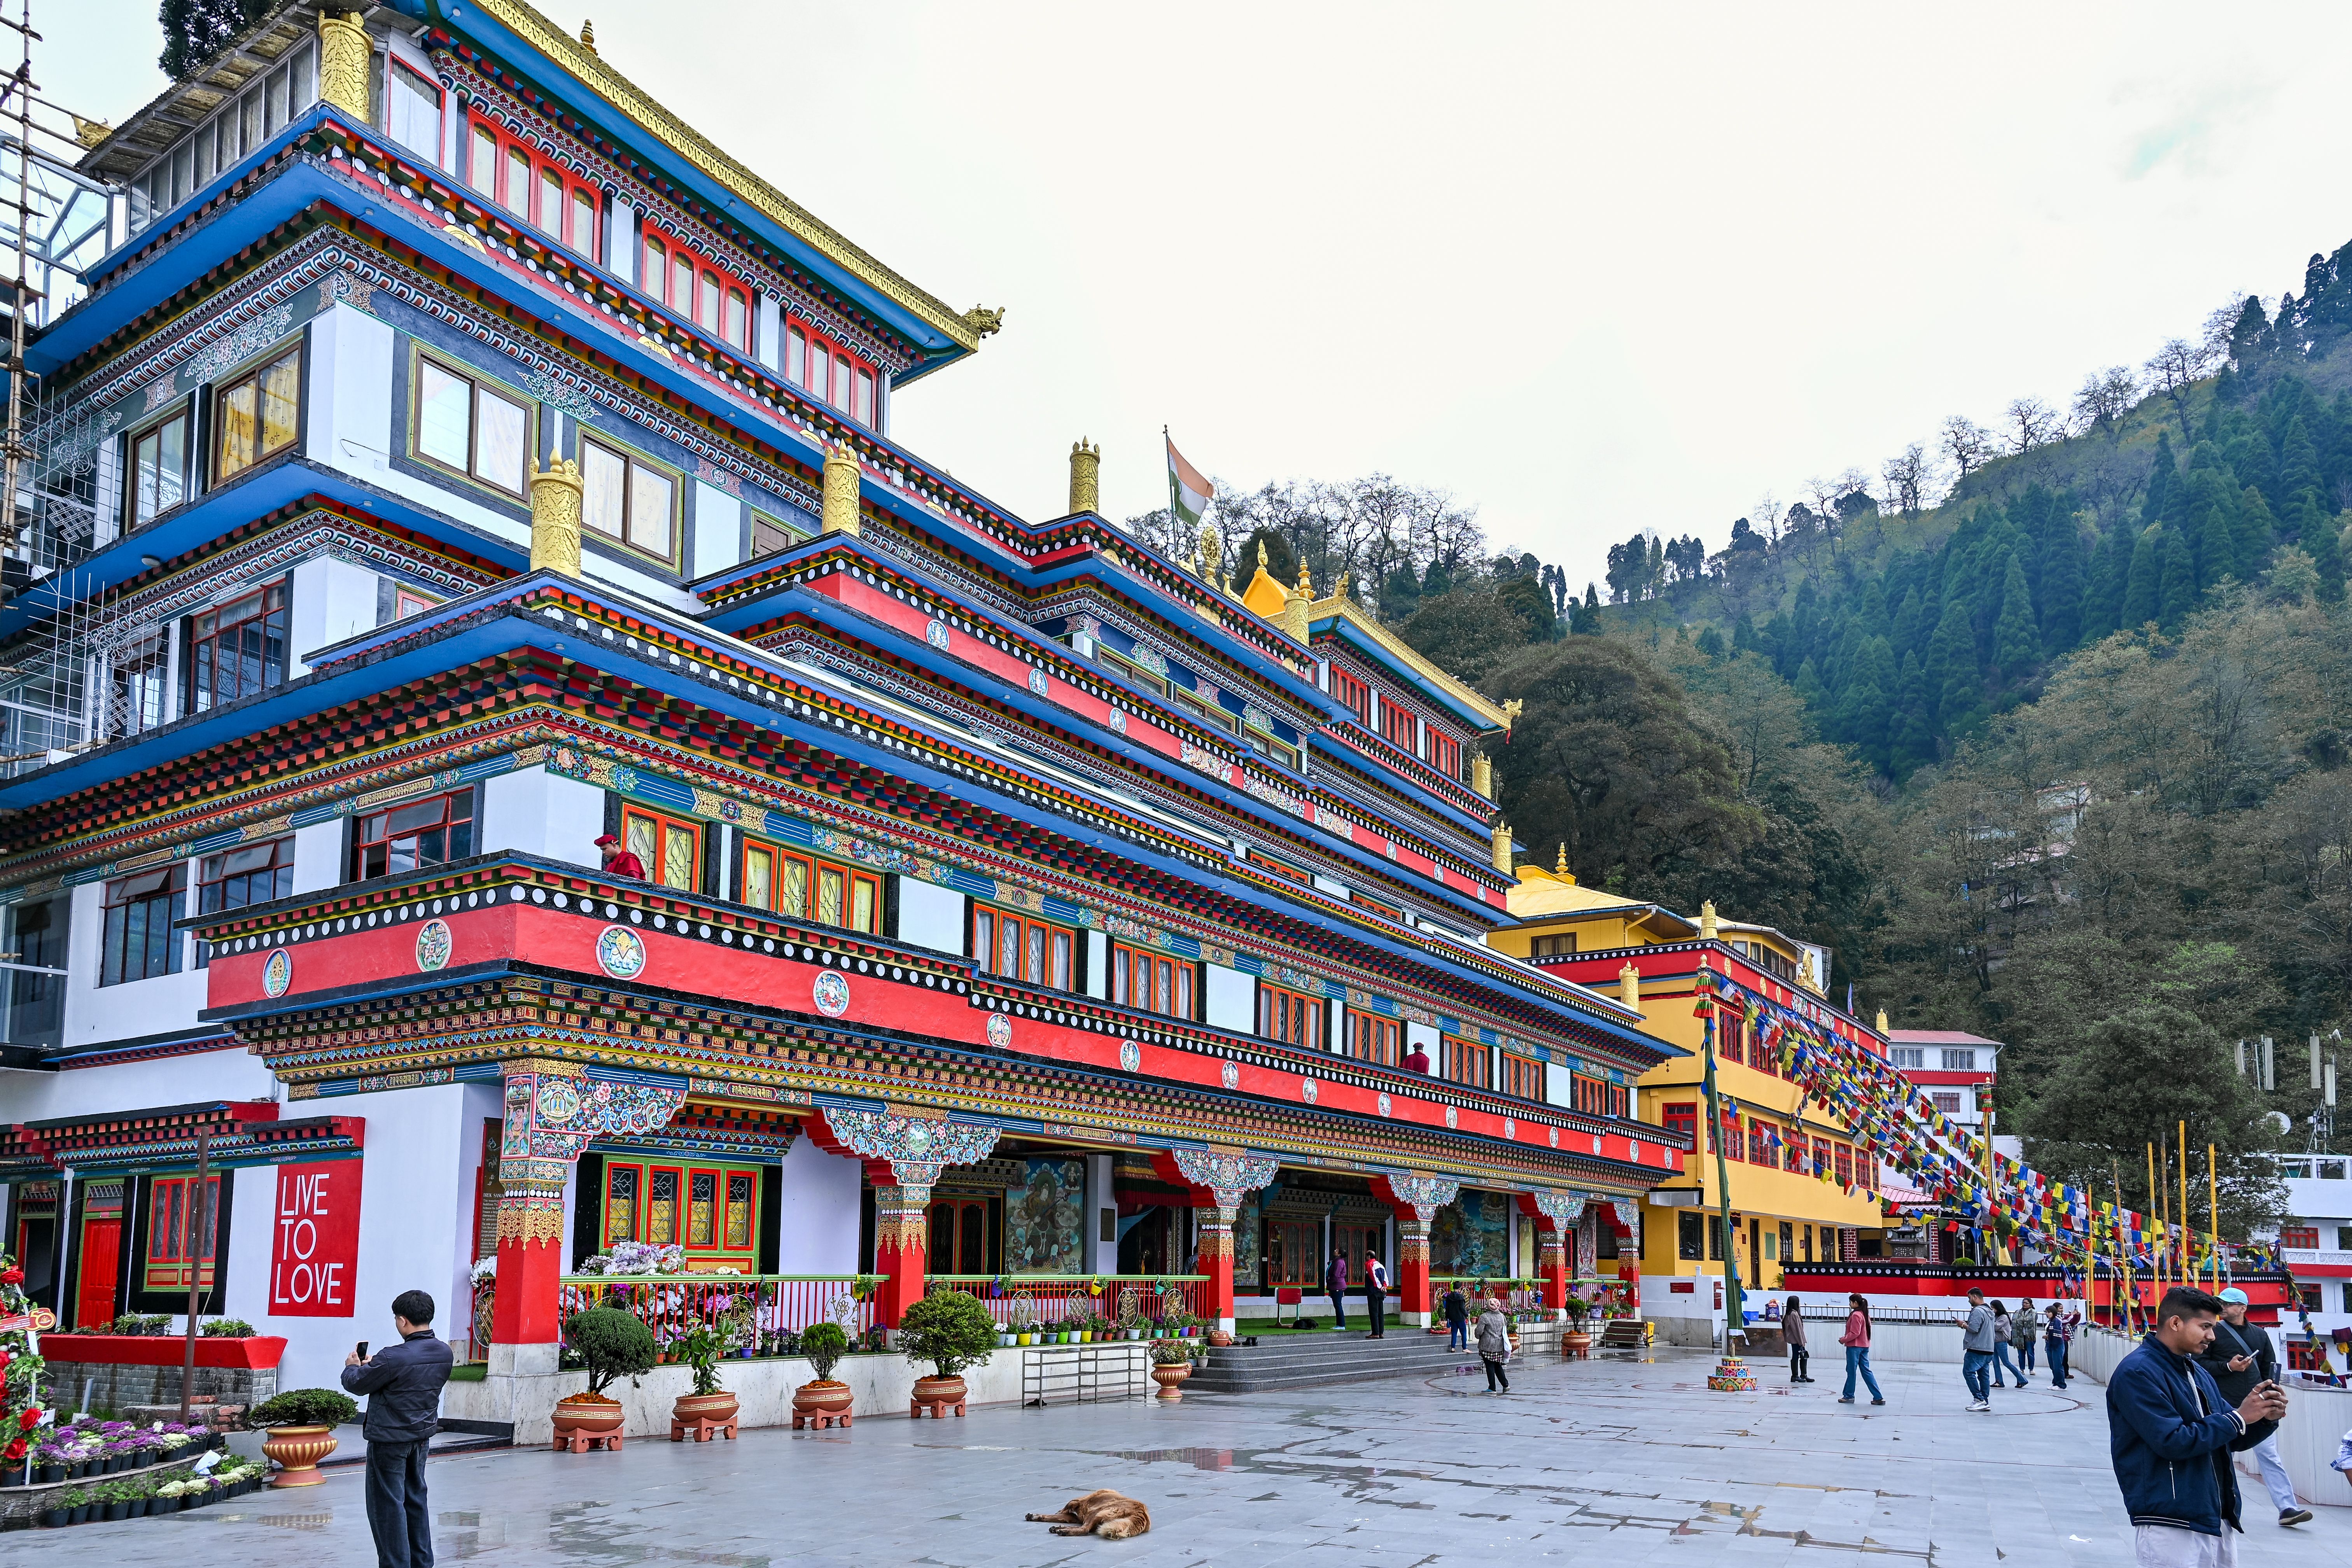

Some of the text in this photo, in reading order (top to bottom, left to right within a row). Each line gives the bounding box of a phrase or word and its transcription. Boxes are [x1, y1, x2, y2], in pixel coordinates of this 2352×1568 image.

[281, 1173, 330, 1216] LIVE
[280, 1218, 317, 1260] TO
[275, 1263, 343, 1304] LOVE
